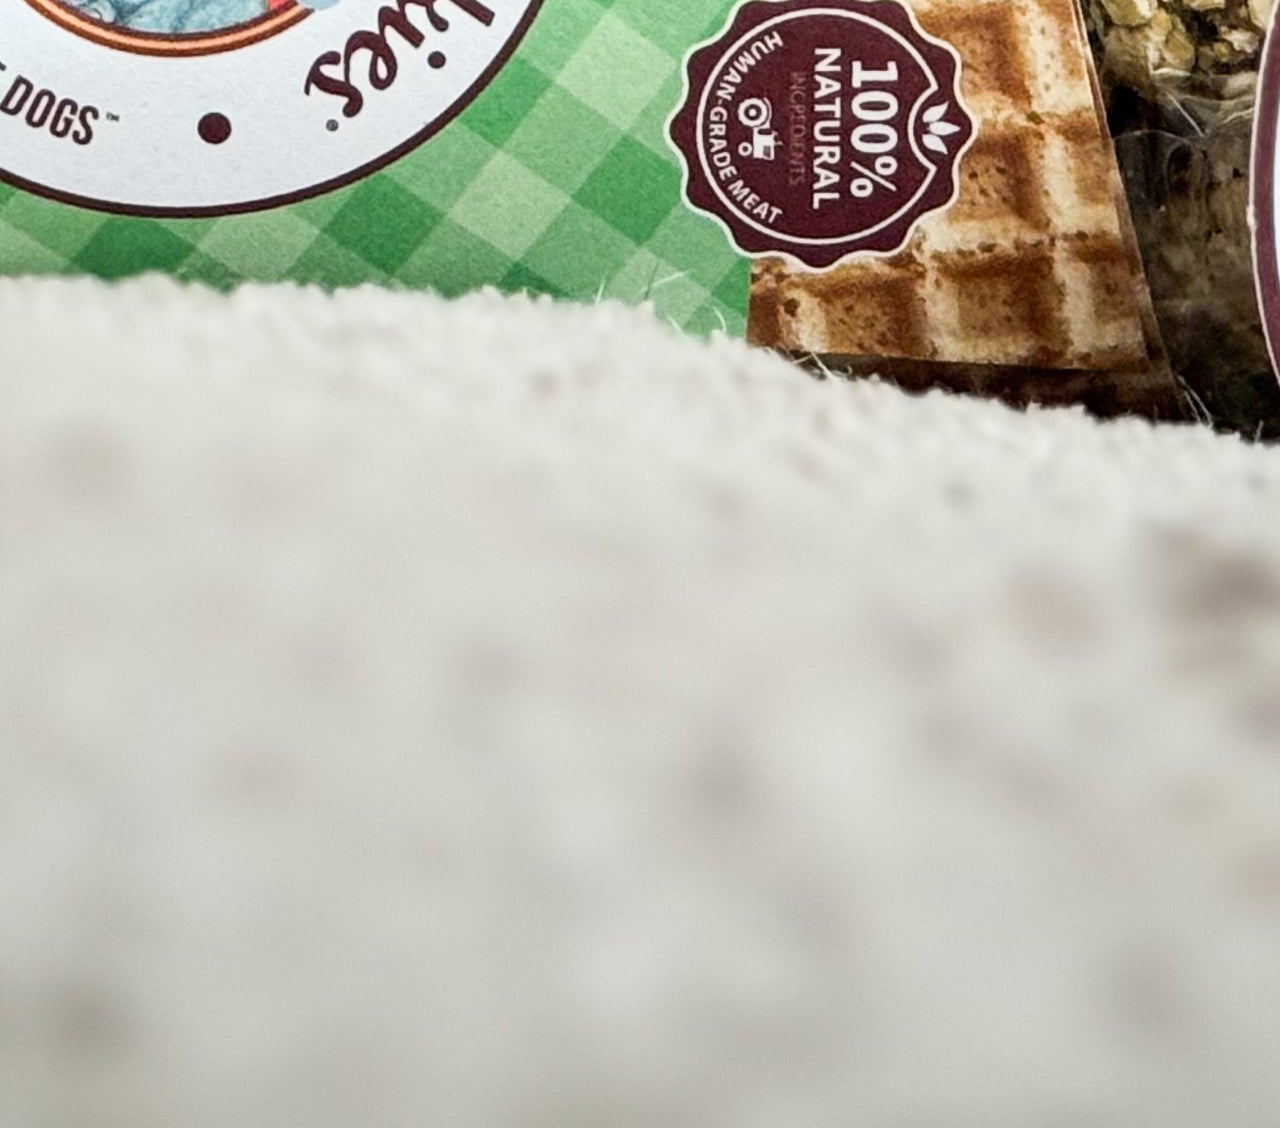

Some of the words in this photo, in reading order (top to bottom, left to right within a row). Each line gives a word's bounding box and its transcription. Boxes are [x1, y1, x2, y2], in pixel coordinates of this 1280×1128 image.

[709, 31, 784, 180] HUMAN-GRADE
[813, 48, 841, 209] NATURAL
[850, 61, 898, 197] 100%
[728, 176, 783, 224] MEAT
